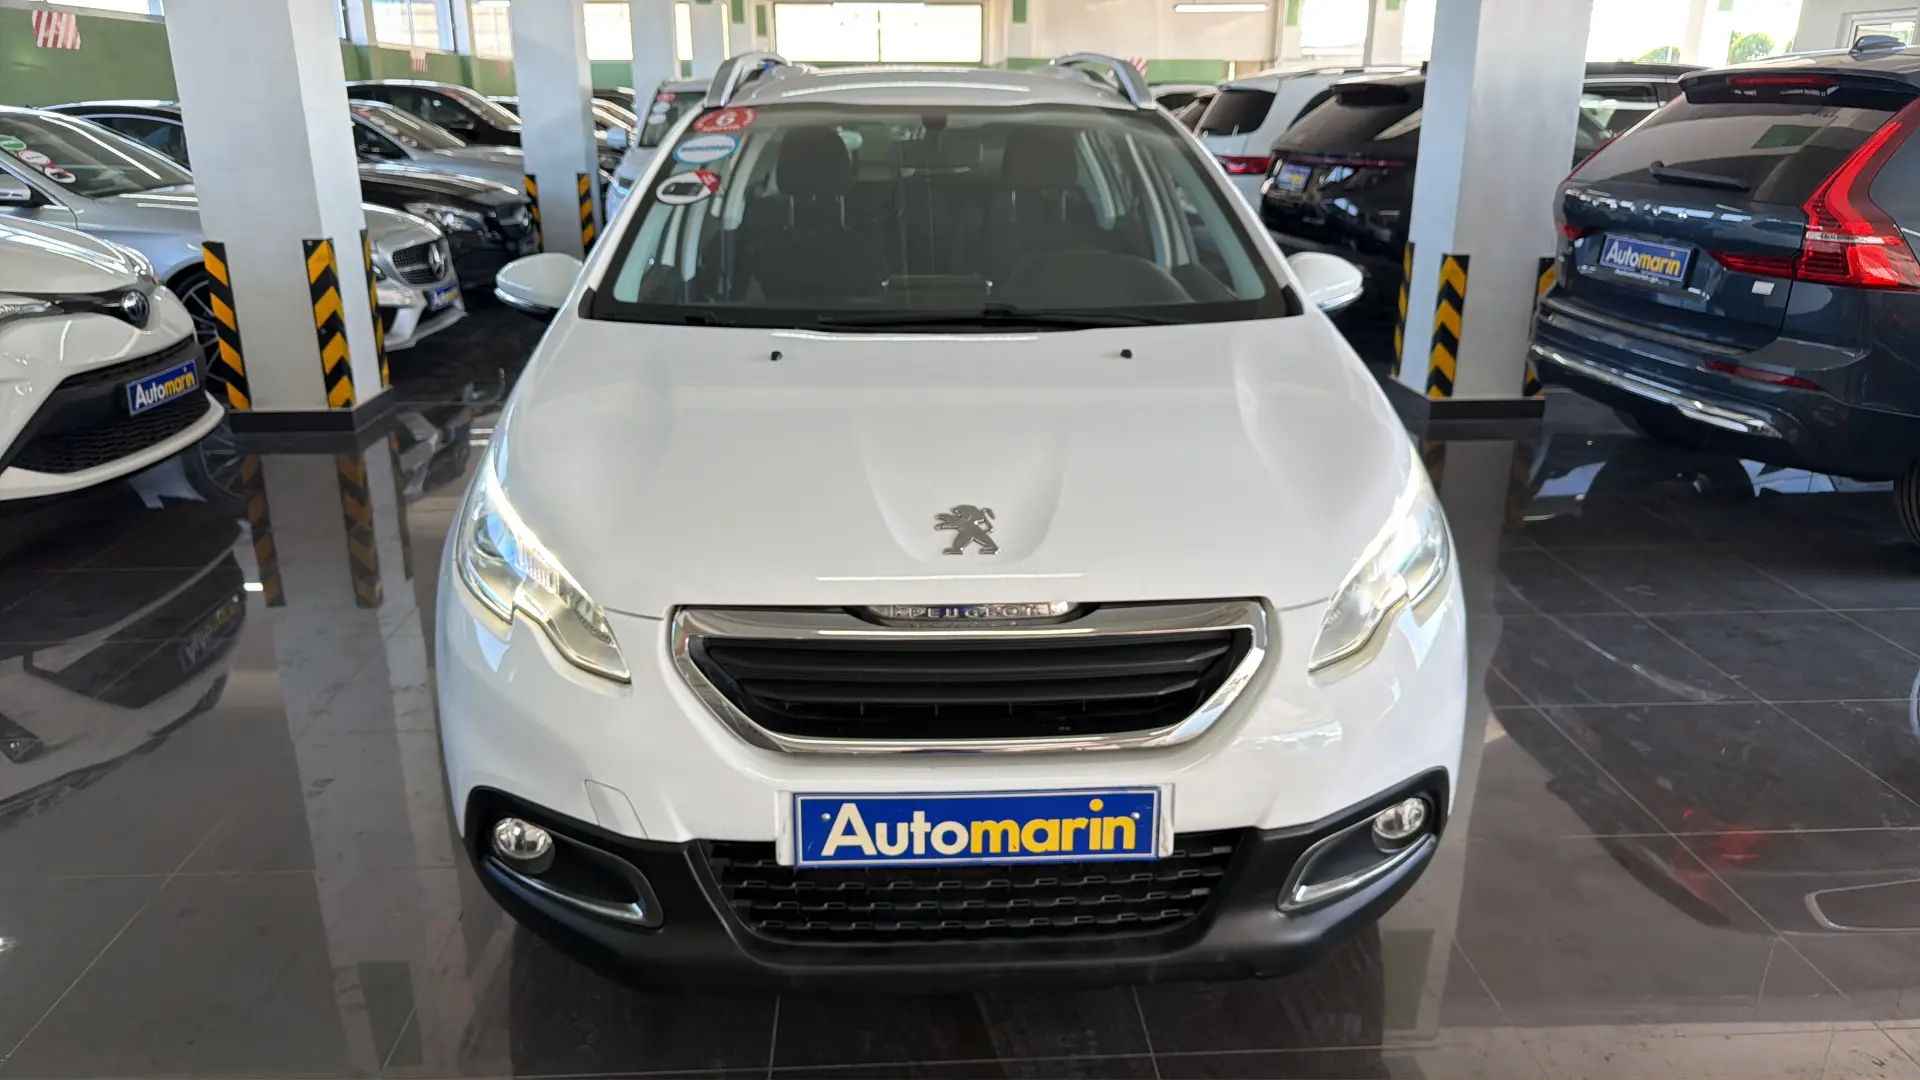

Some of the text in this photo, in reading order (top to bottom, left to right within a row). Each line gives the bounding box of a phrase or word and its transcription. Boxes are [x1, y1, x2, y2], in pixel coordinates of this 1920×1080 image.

[1605, 240, 1681, 277] Automarin
[135, 366, 195, 409] Automarin
[820, 797, 1137, 857] Automarin
